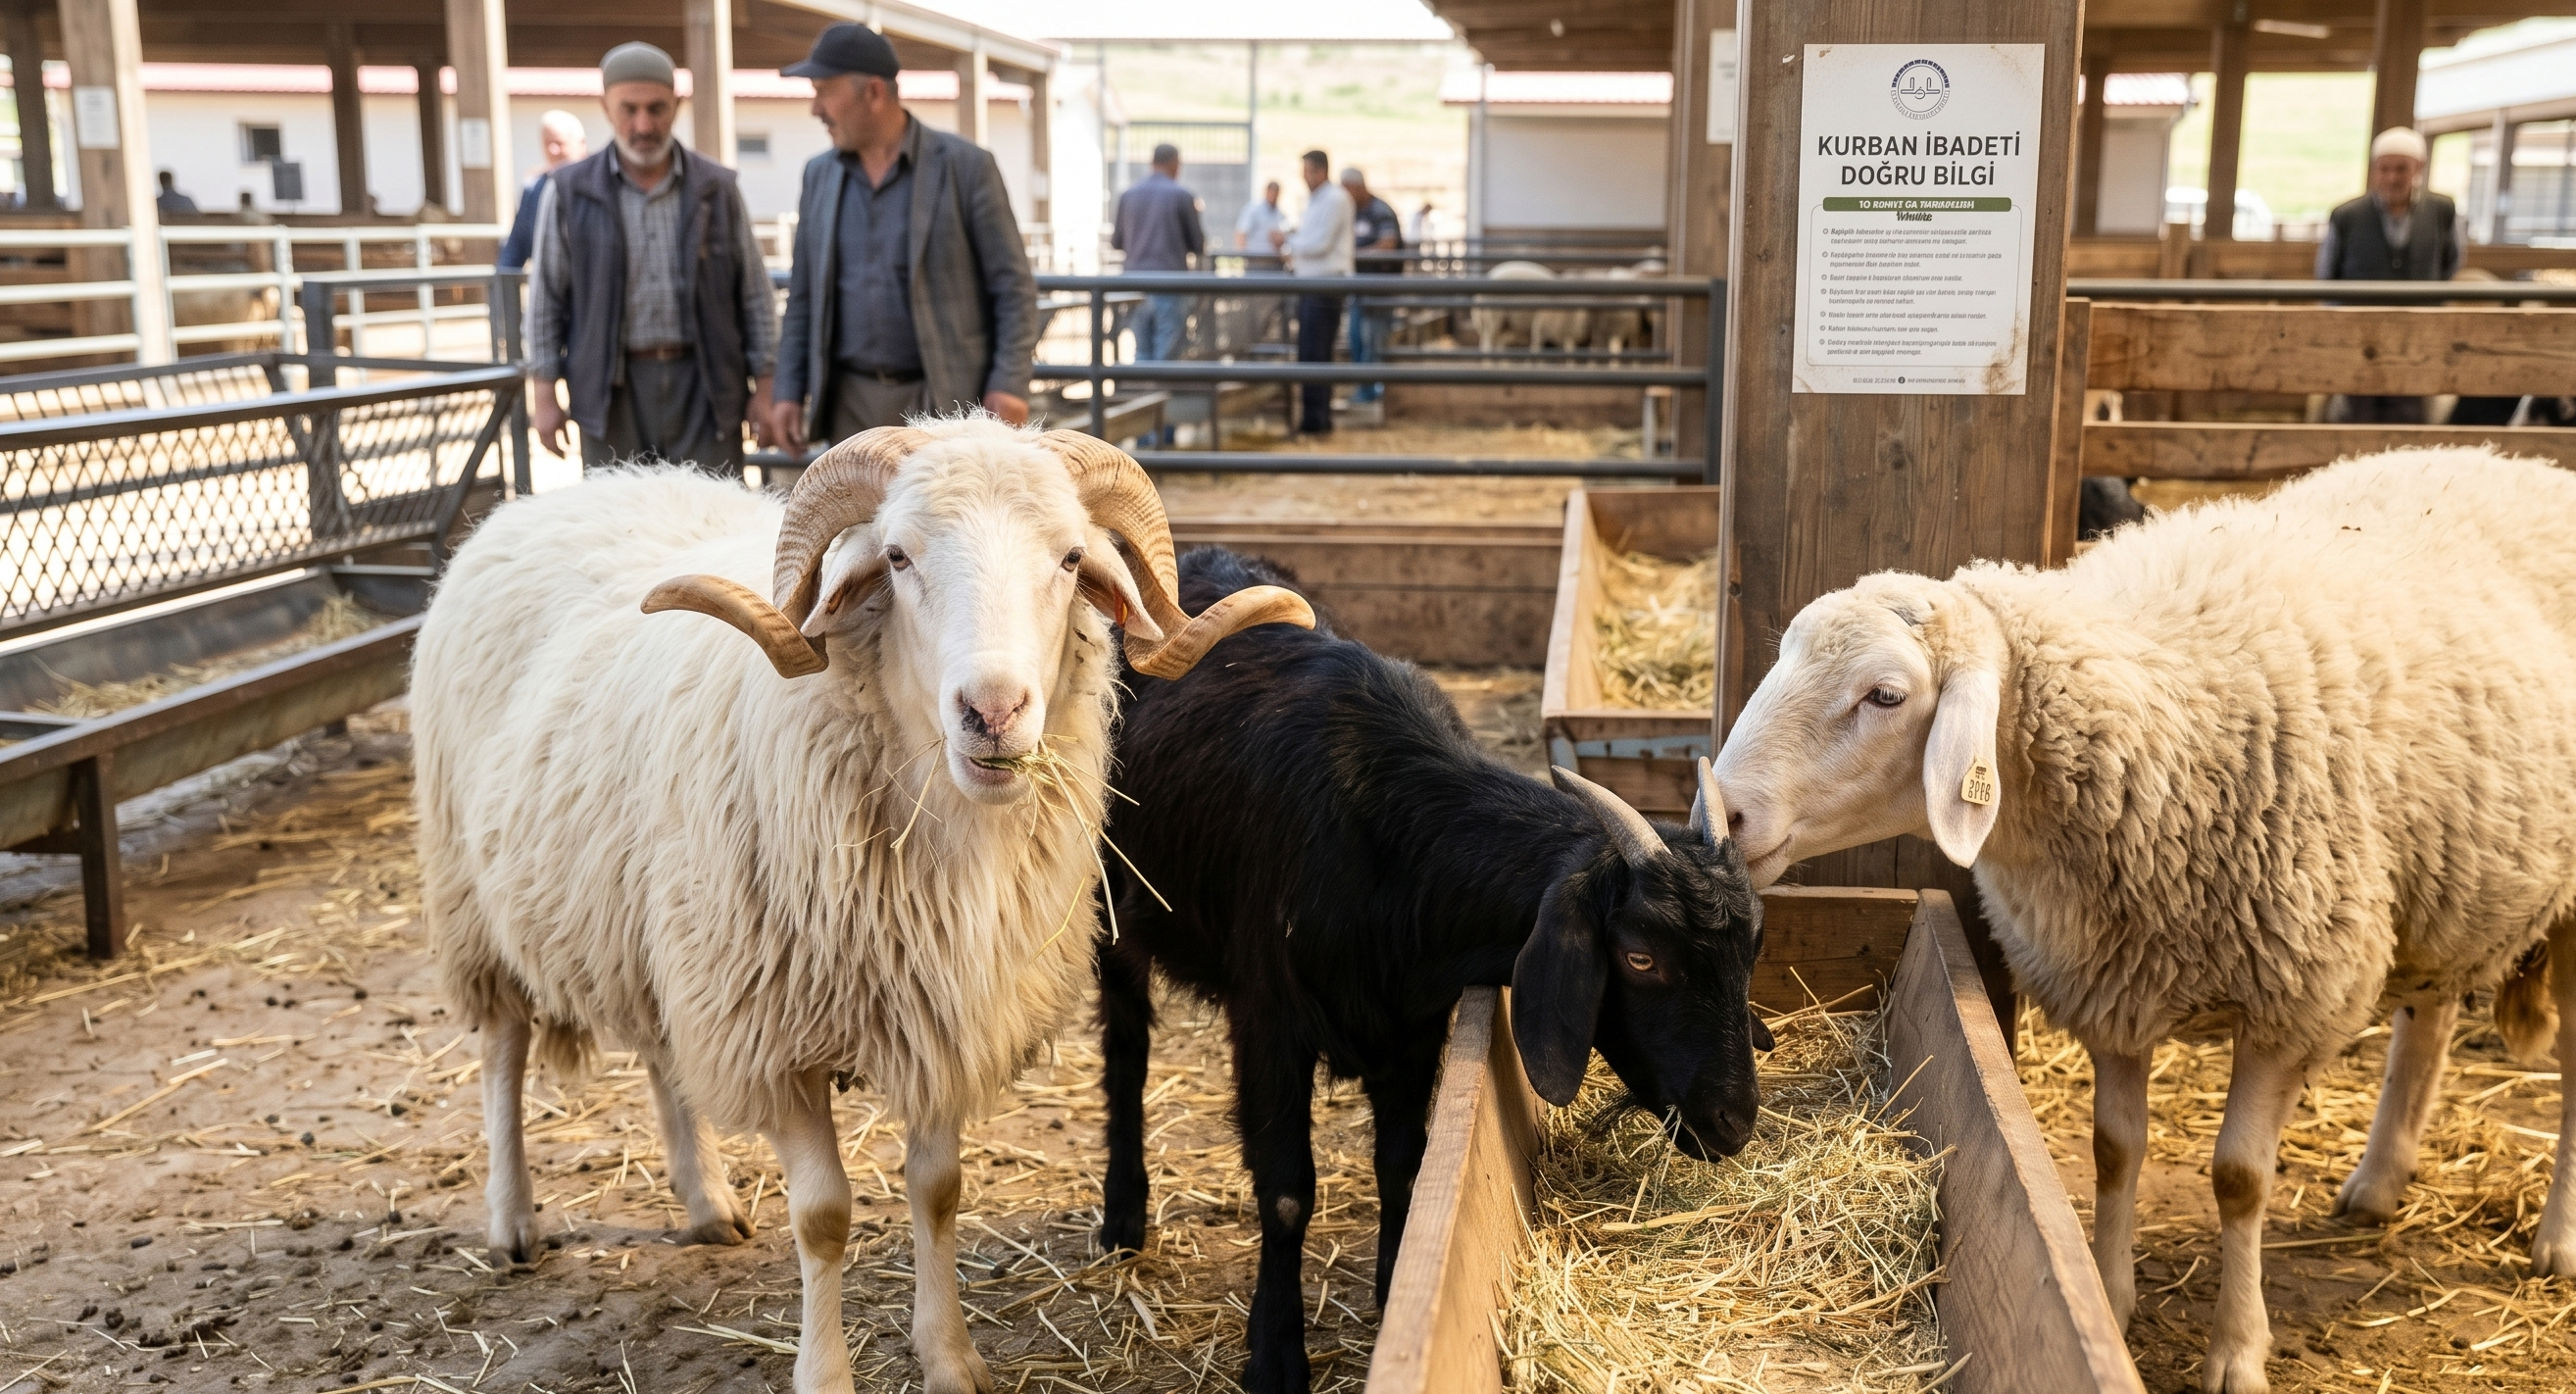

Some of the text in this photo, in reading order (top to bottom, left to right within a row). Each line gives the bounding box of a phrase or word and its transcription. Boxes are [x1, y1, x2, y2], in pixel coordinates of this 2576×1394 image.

[1817, 130, 2020, 156] KURBAN İBADETİ
[1841, 161, 1995, 185] DOĞRU BİLGİ
